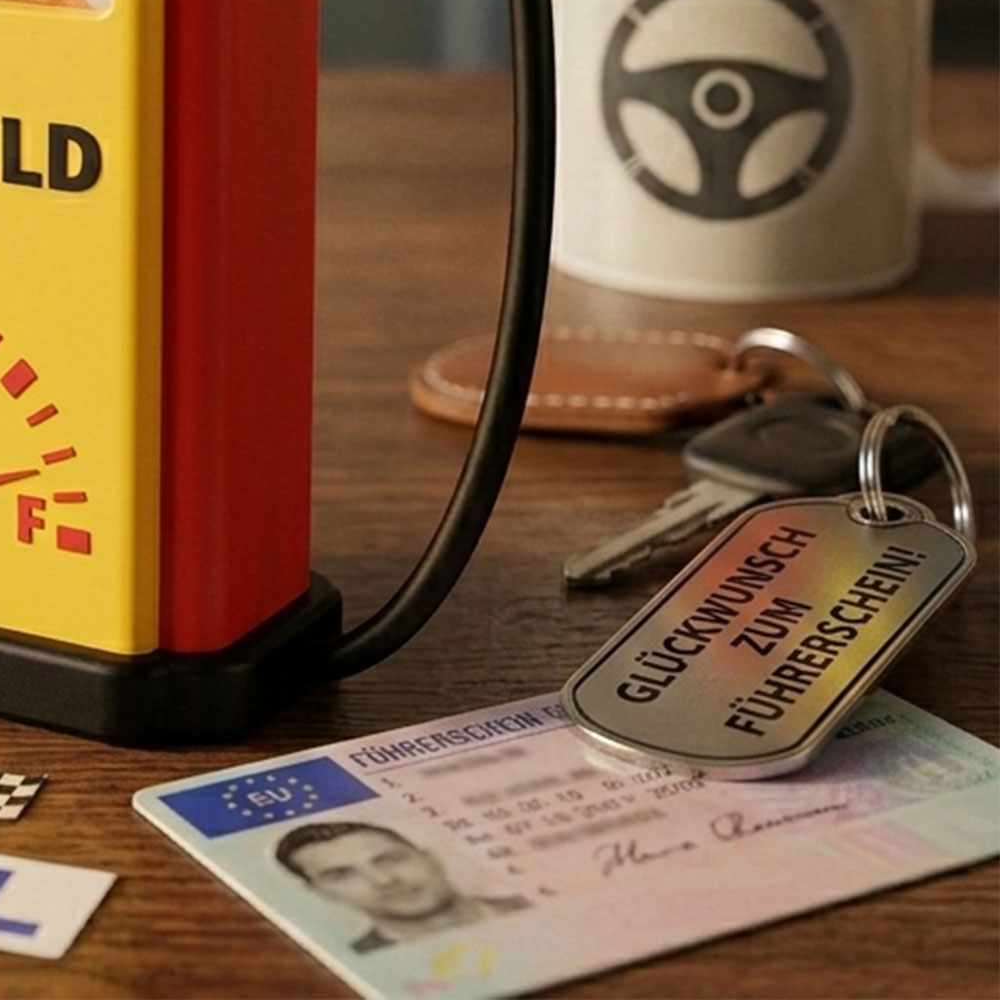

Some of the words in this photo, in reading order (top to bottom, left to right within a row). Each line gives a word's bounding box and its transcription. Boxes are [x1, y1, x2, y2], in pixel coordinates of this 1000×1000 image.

[17, 494, 46, 544] F
[616, 526, 817, 703] GLÜCKWUNSCH
[724, 545, 928, 737] FÜHRERSCHEIN!
[730, 597, 813, 656] ZUM
[247, 787, 292, 807] EU
